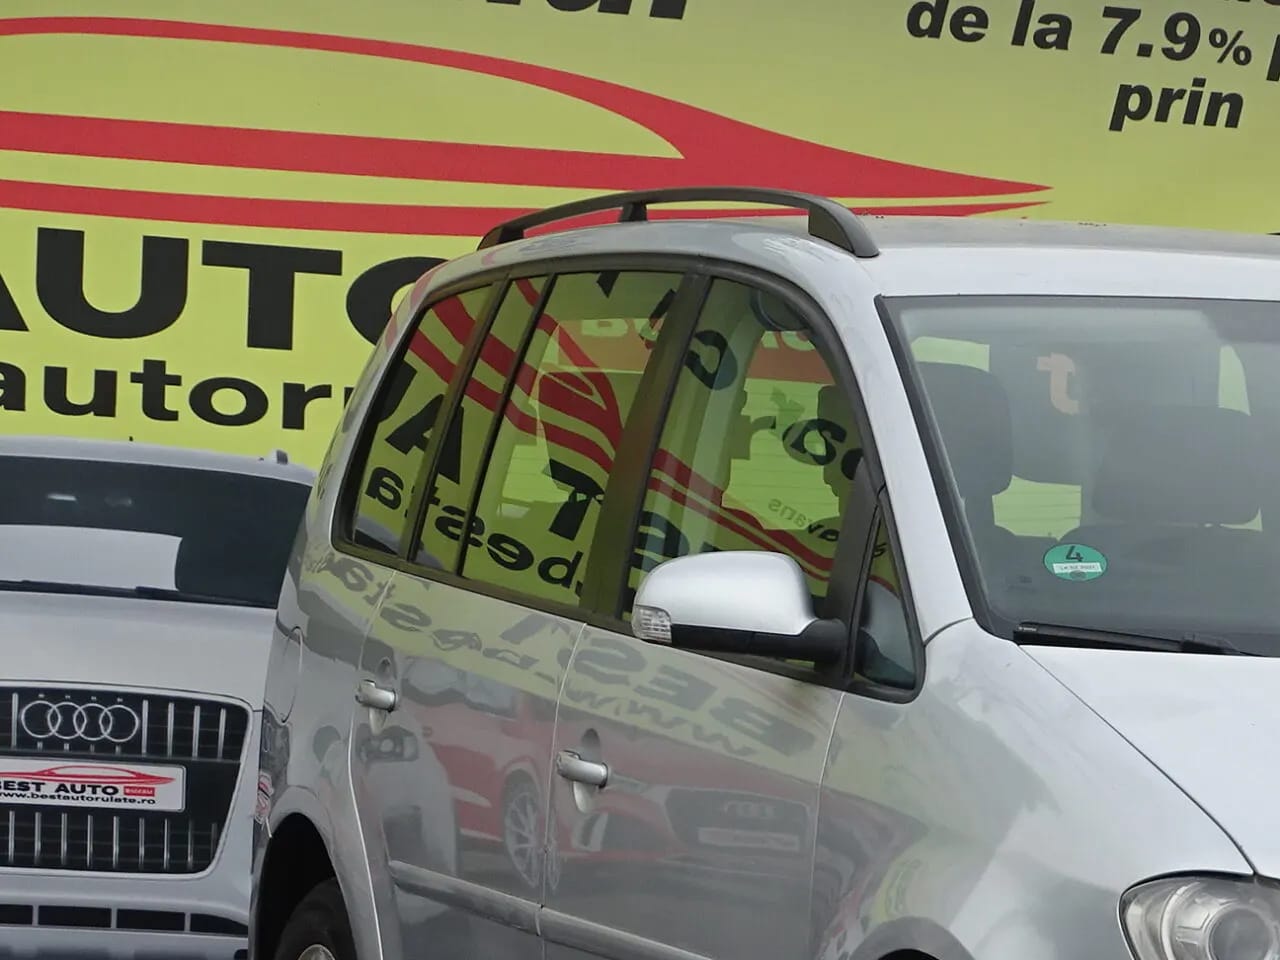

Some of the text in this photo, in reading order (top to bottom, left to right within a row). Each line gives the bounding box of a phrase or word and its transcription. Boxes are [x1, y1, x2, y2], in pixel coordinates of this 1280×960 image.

[906, 0, 989, 42] de
[1011, 0, 1073, 50] la
[1109, 77, 1244, 131] prin
[55, 783, 120, 796] AUTO
